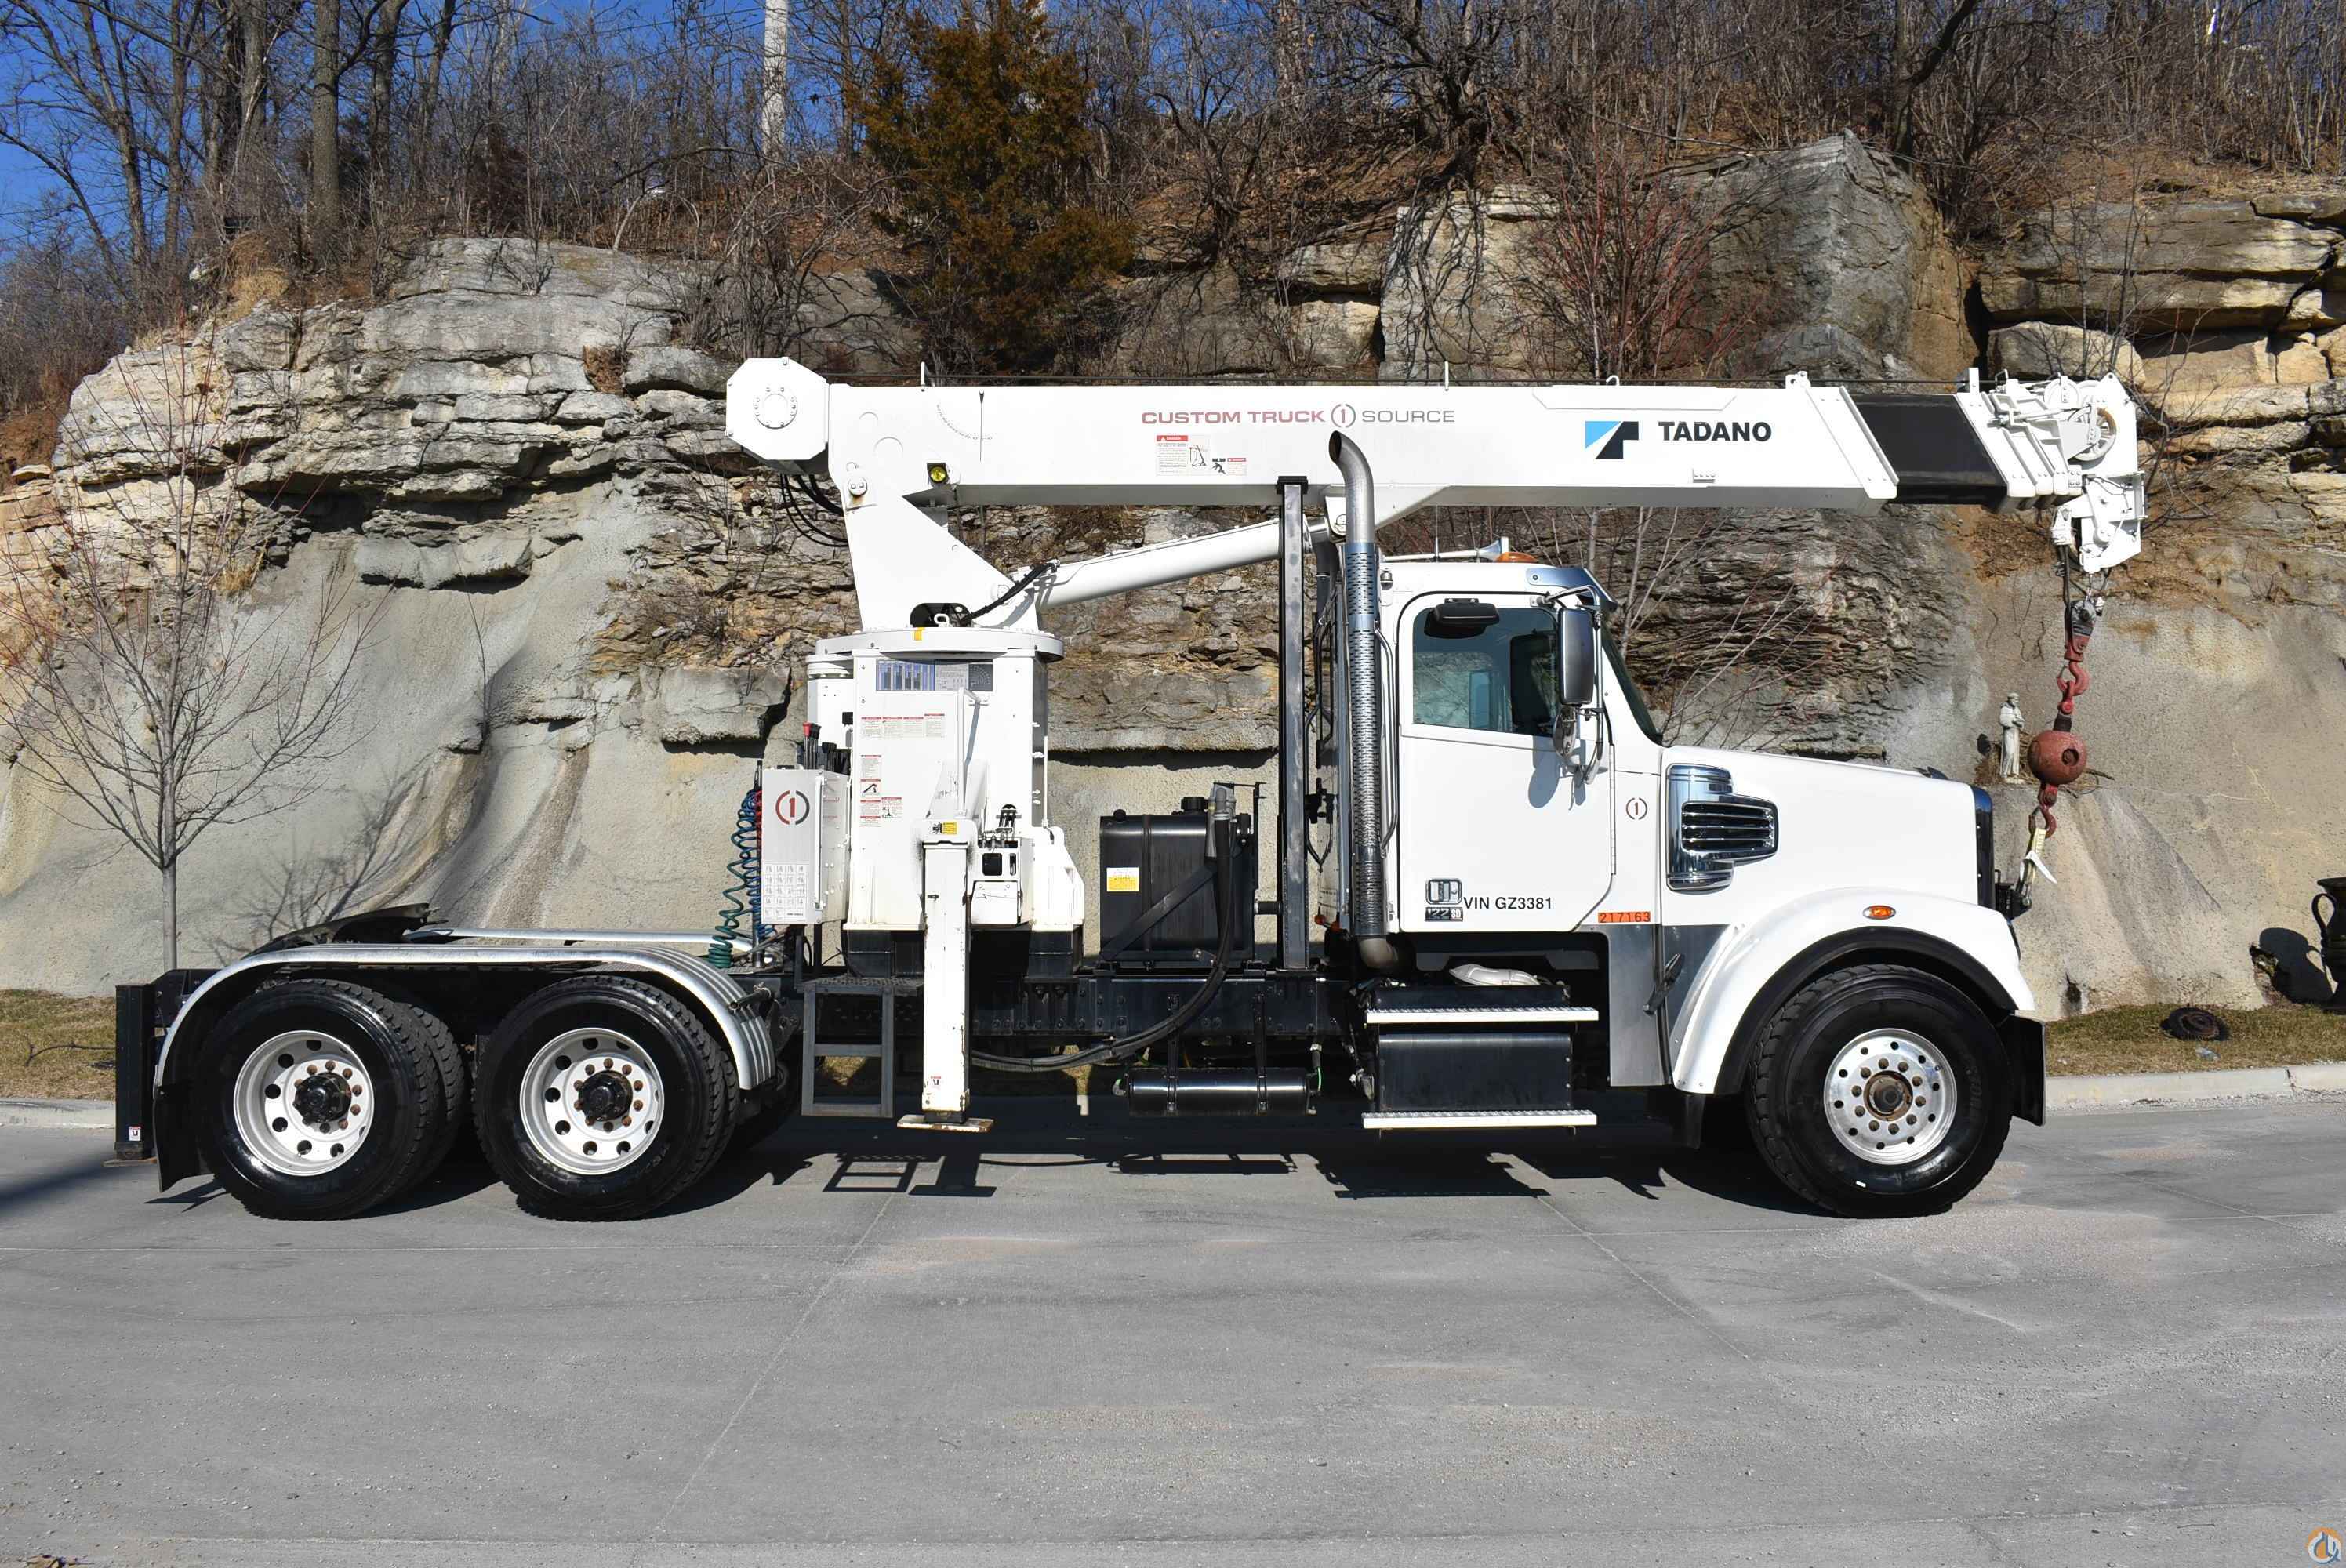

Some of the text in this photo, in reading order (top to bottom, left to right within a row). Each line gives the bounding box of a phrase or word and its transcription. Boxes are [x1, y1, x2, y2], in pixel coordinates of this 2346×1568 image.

[1142, 411, 1241, 424] CUSTOM
[1247, 410, 1325, 423] TRUCK
[1362, 410, 1455, 423] SOURCE
[1658, 421, 1772, 441] TADANO
[1463, 896, 1551, 909] VIN GZ3381
[1600, 912, 1651, 923] 217163
